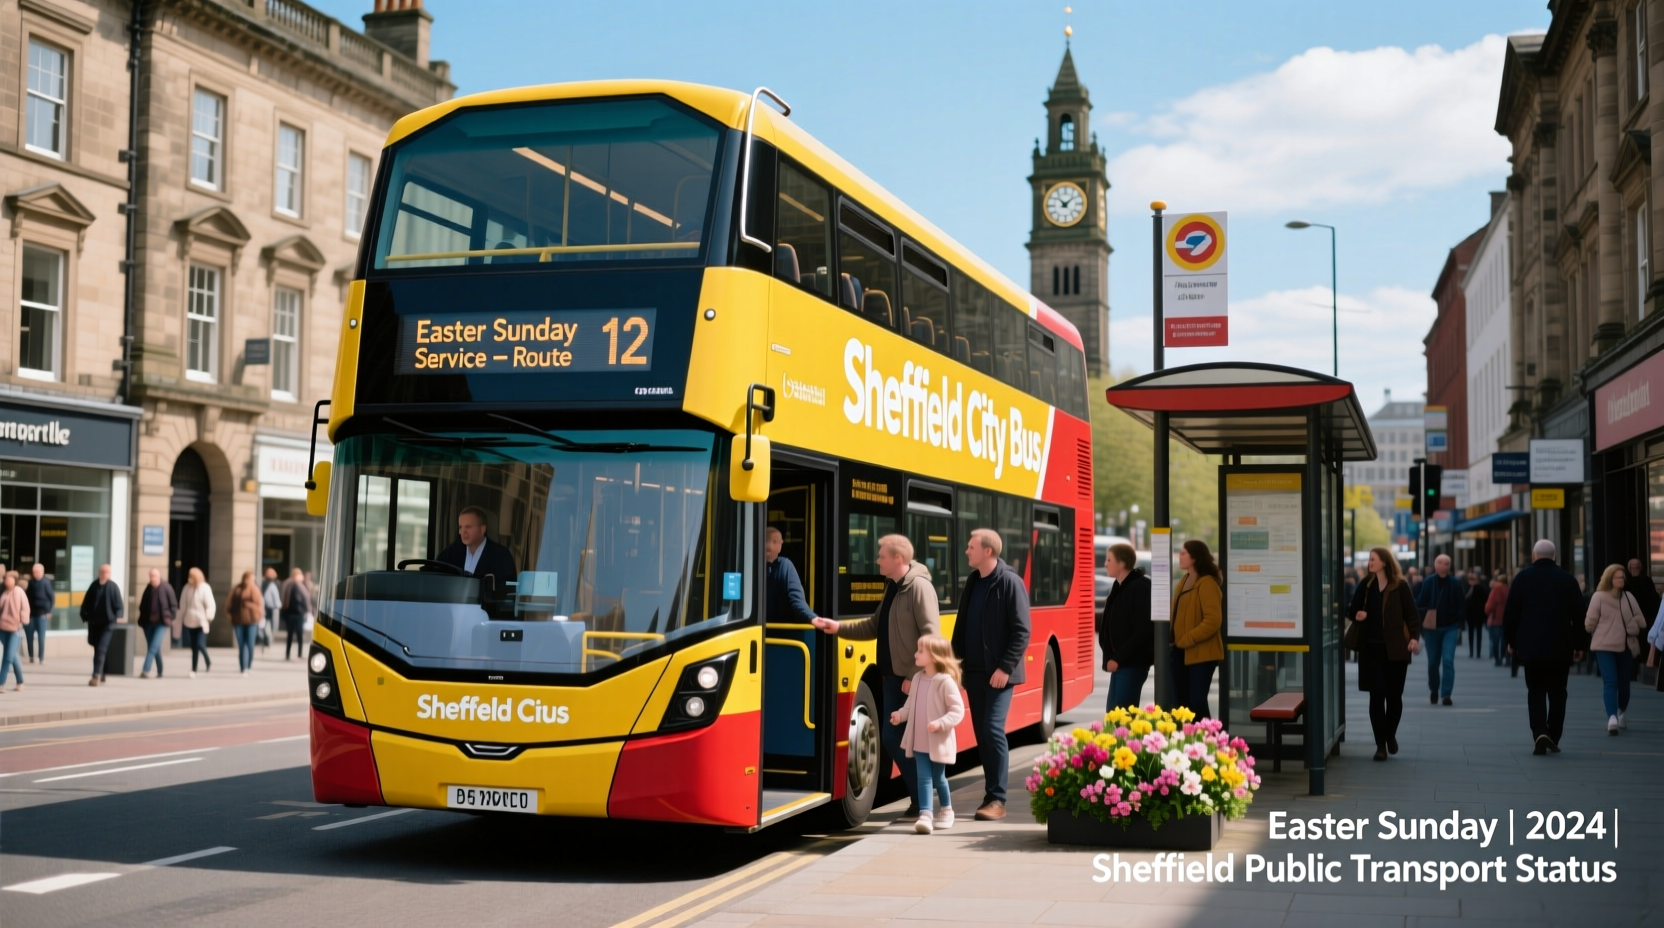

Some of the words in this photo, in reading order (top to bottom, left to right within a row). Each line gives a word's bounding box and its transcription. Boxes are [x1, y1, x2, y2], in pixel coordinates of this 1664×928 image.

[416, 319, 487, 344] Easter
[493, 316, 578, 347] Sunday
[602, 316, 649, 365] 12
[414, 347, 487, 369] Service
[513, 346, 573, 368] Route
[843, 337, 963, 453] Sheffield
[966, 389, 1007, 480] City
[1009, 406, 1042, 474] Bus
[416, 693, 513, 723] Sheffeld
[516, 697, 570, 725] Cius
